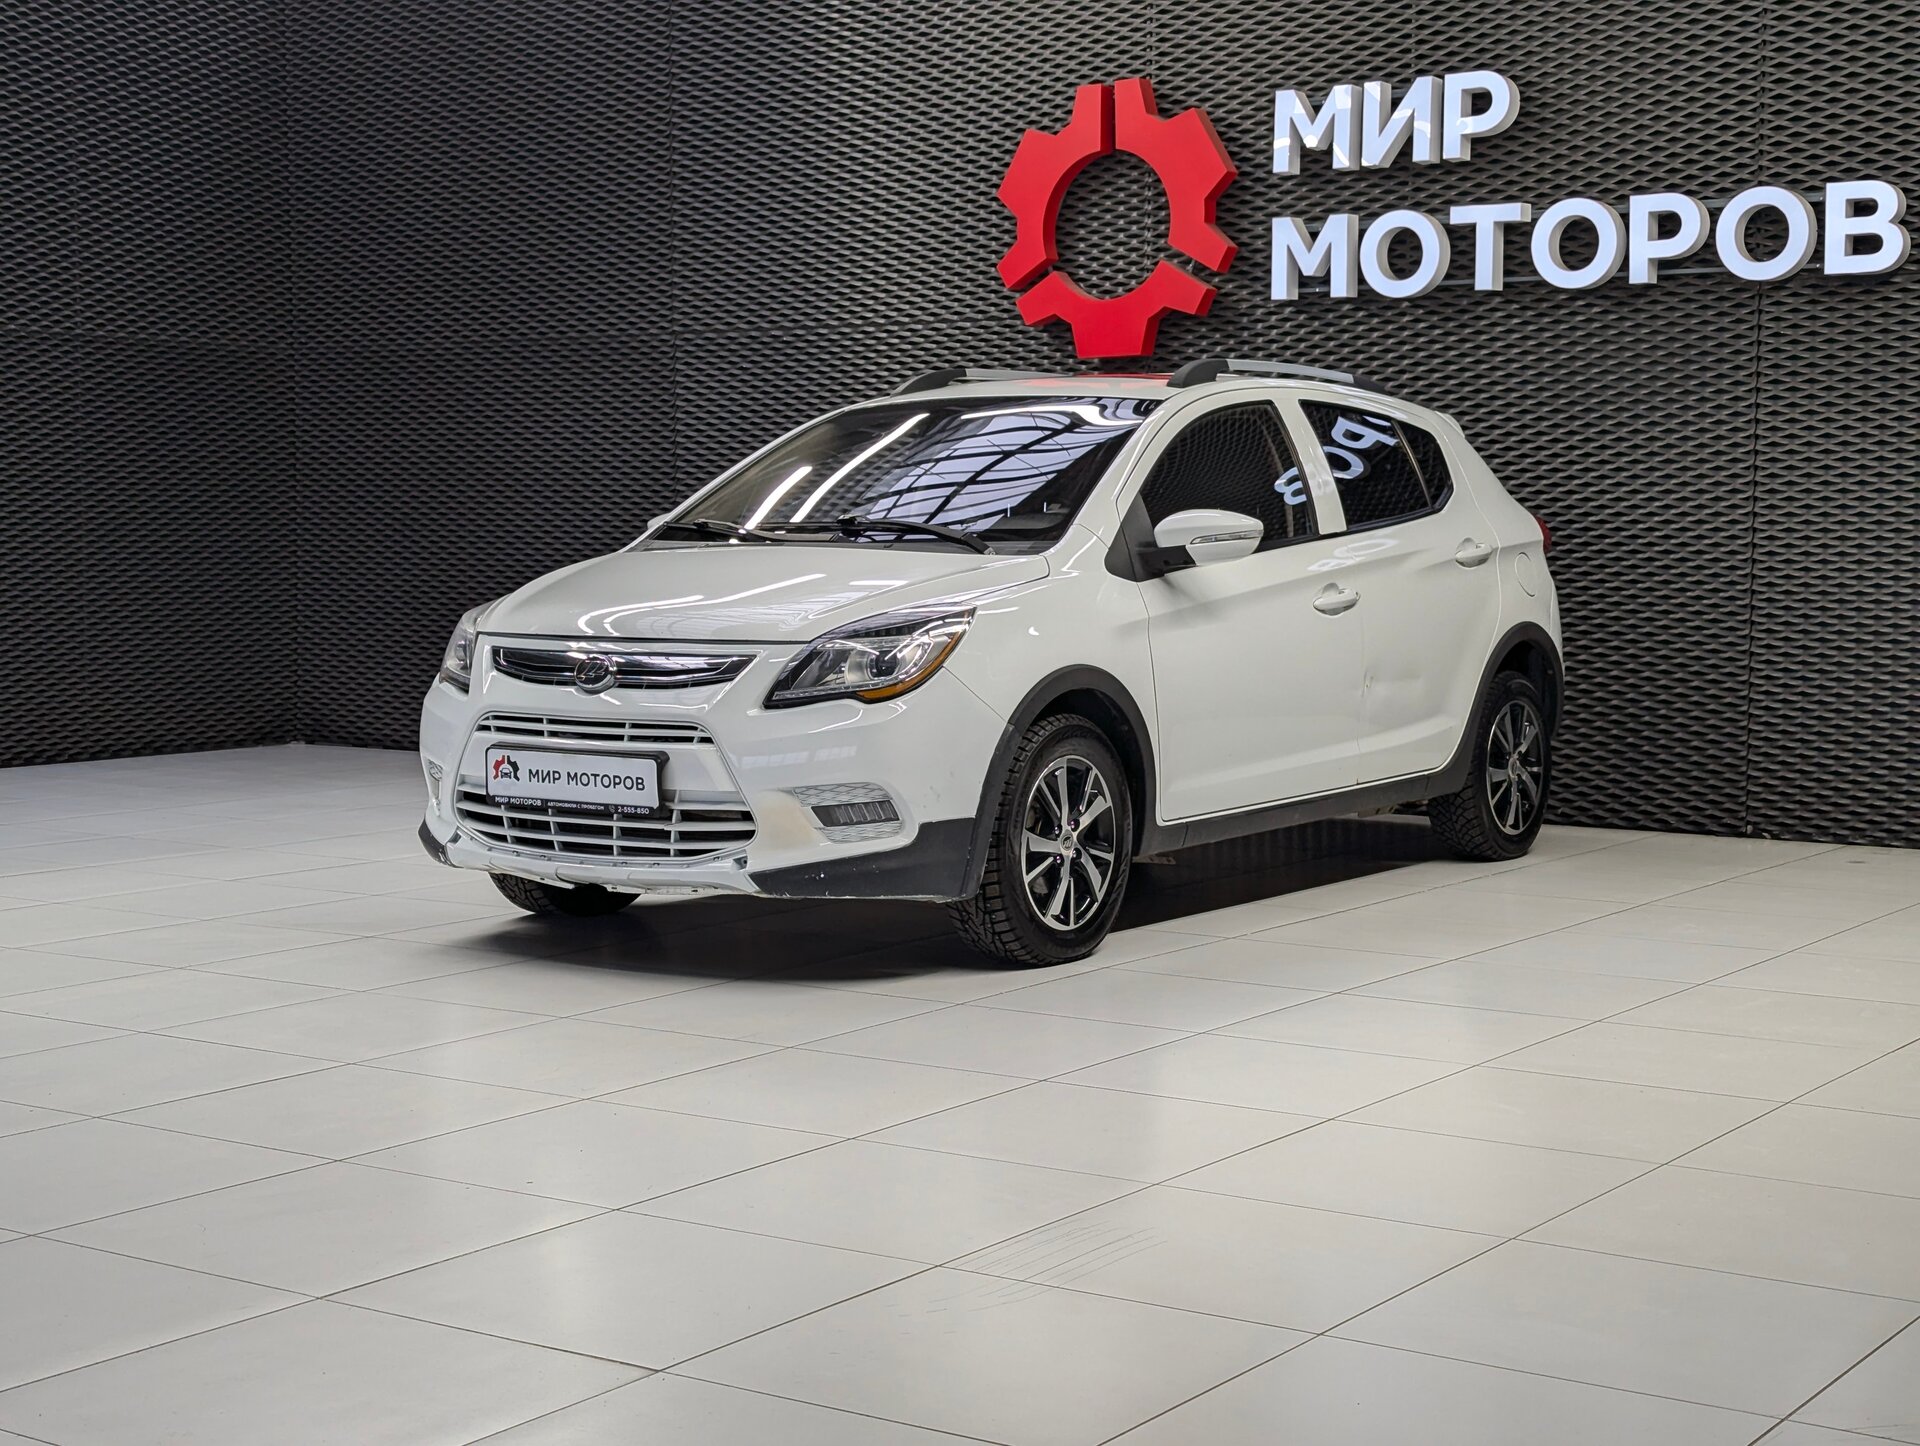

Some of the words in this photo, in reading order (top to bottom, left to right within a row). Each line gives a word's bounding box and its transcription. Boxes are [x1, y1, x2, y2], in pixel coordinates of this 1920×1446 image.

[1273, 70, 1520, 176] МИР
[1271, 179, 1911, 301] МОТОРОВ
[495, 795, 509, 804] МИР
[510, 797, 542, 807] МОТОРОВ
[528, 768, 562, 784] МИР
[567, 771, 646, 791] МОТОРОВ
